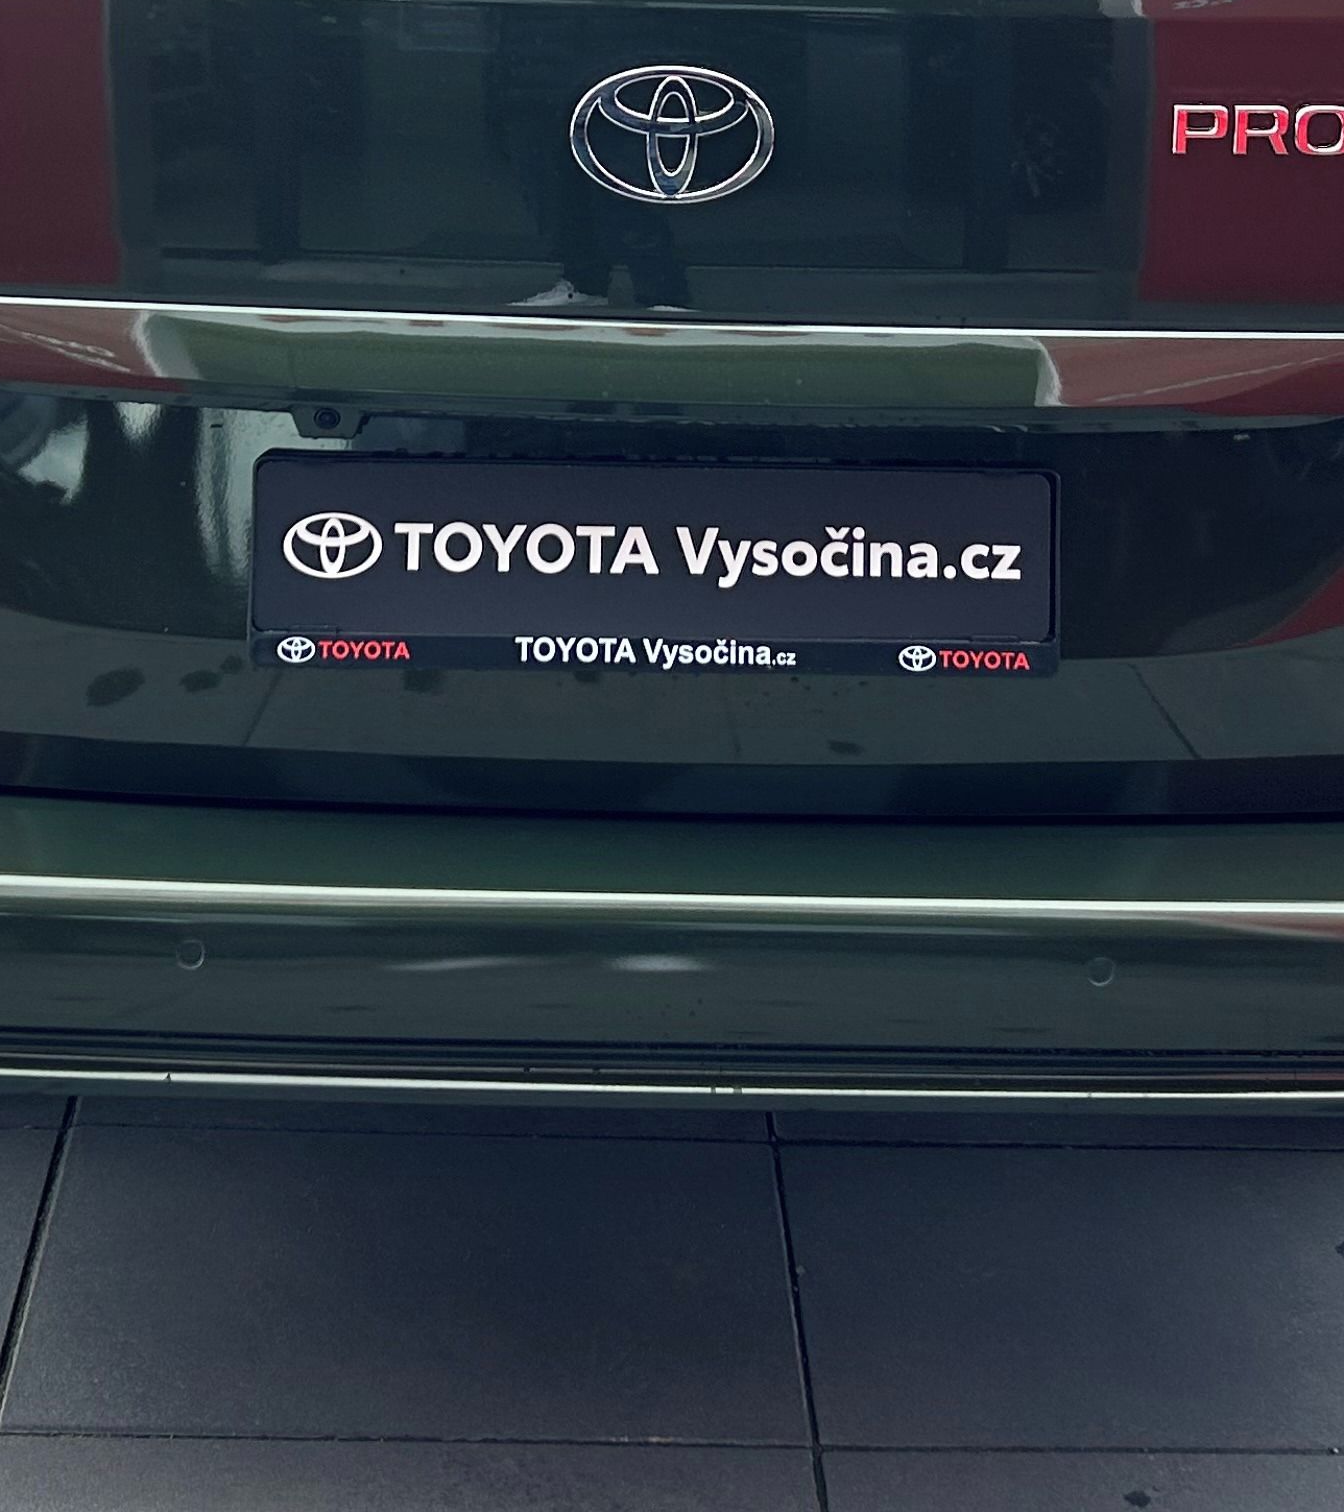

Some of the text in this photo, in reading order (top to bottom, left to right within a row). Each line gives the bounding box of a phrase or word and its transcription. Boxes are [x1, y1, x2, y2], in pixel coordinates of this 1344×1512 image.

[393, 521, 1023, 589] TOYOTA Vysočina.cz
[318, 640, 410, 661] TOYOTA
[514, 636, 796, 671] TOYOTA Vysočina.cz
[938, 649, 1030, 671] TOYOTA
